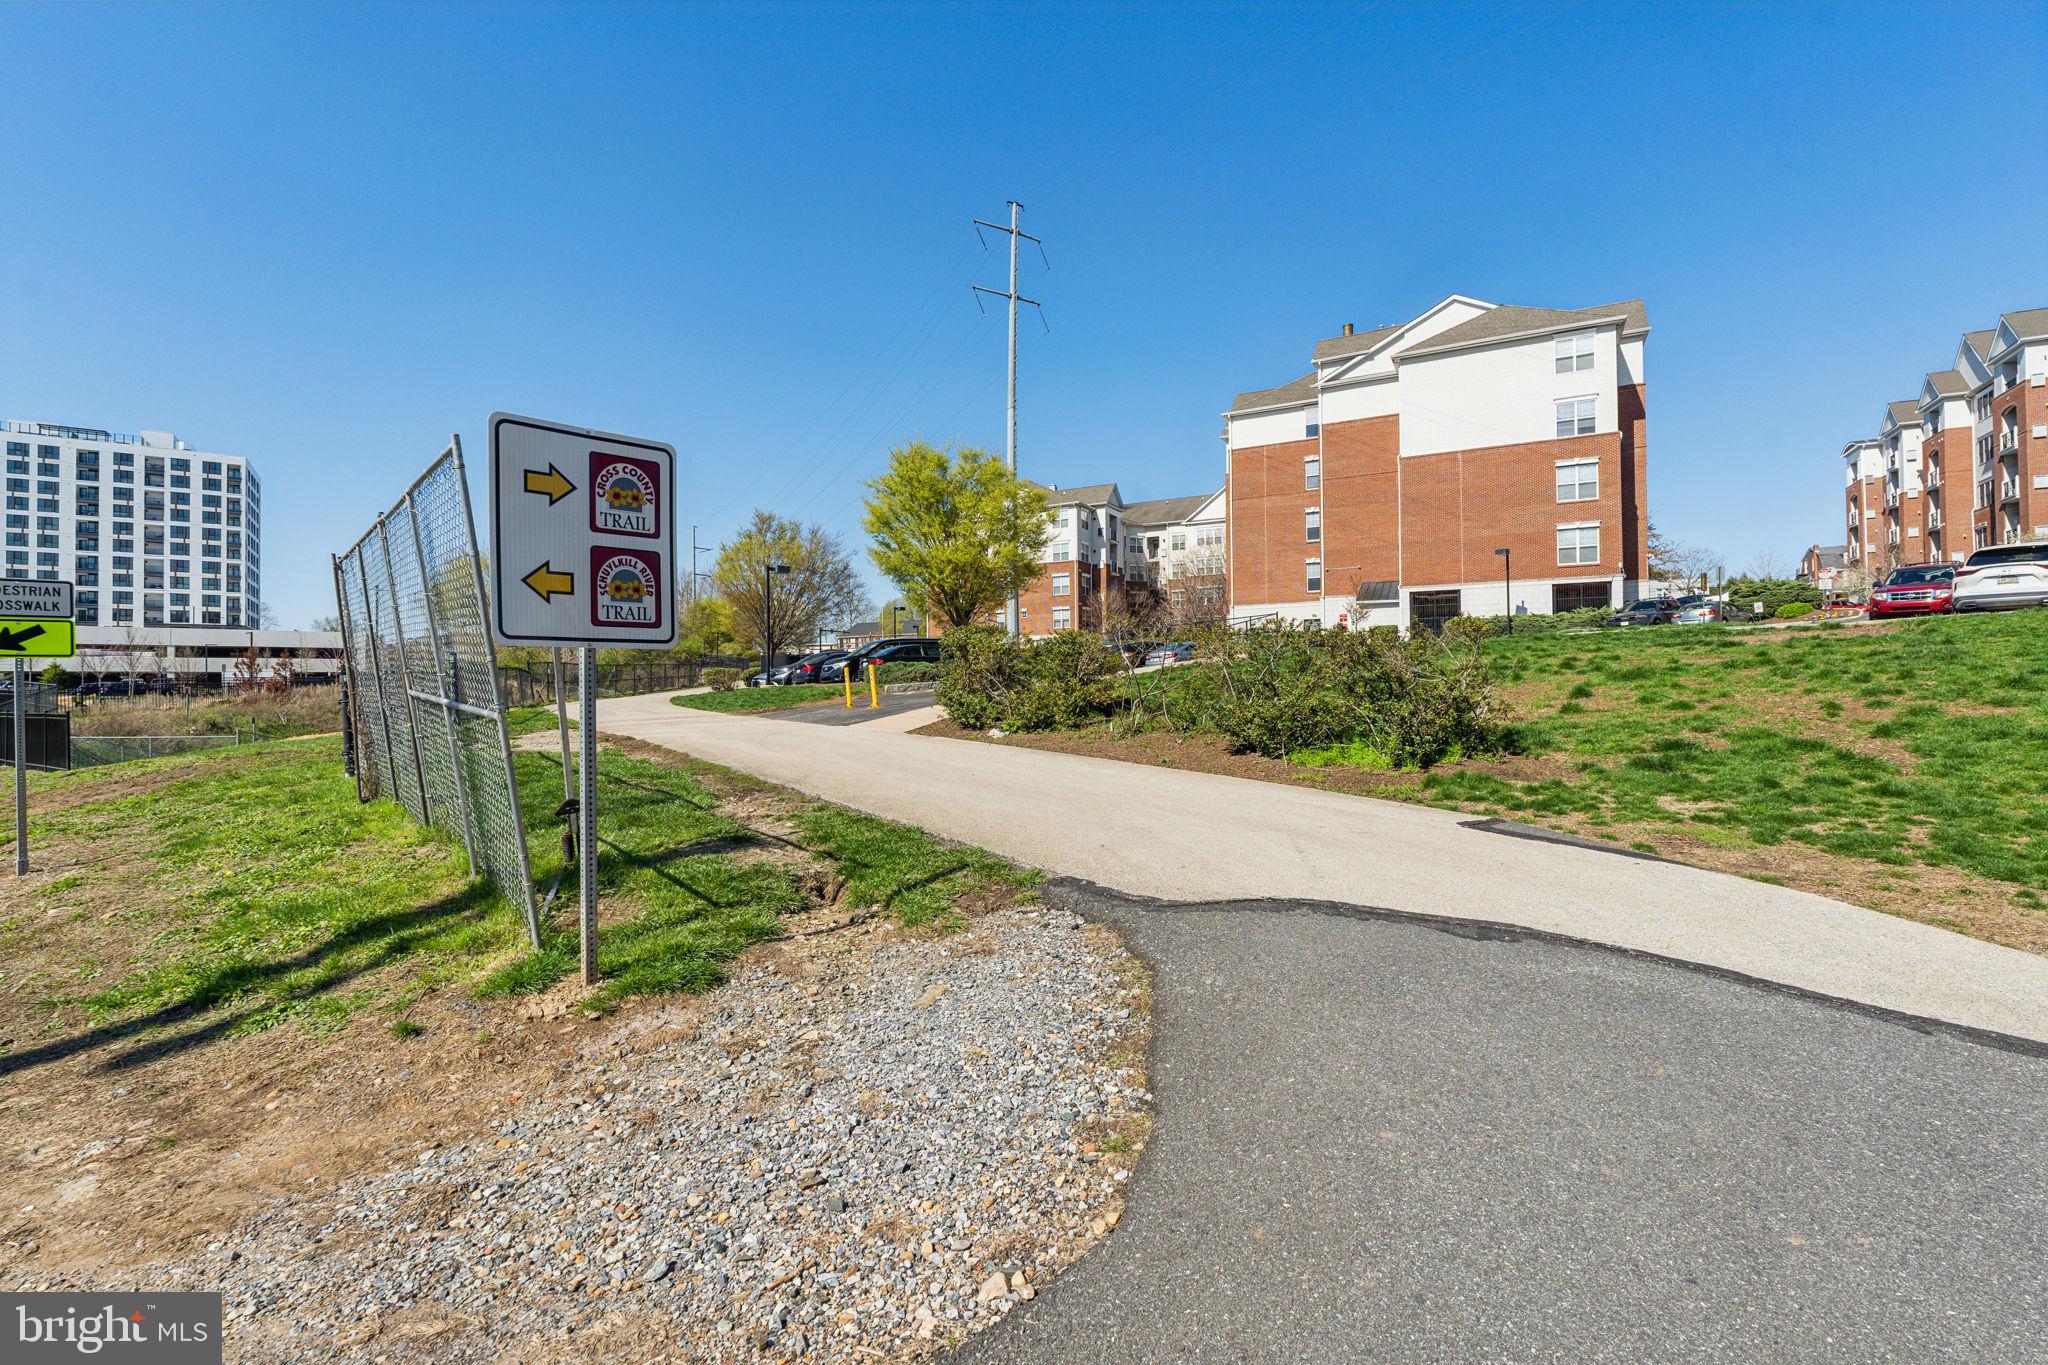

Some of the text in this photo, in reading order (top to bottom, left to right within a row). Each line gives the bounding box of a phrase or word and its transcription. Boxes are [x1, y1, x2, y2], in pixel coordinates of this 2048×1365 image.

[597, 466, 654, 504] CROSS COUNTY
[600, 512, 651, 531] TRAIL
[599, 558, 654, 597] SCHUYLKILL RIVER
[0, 585, 61, 597] ESTRIAN
[602, 605, 652, 621] TRAIL
